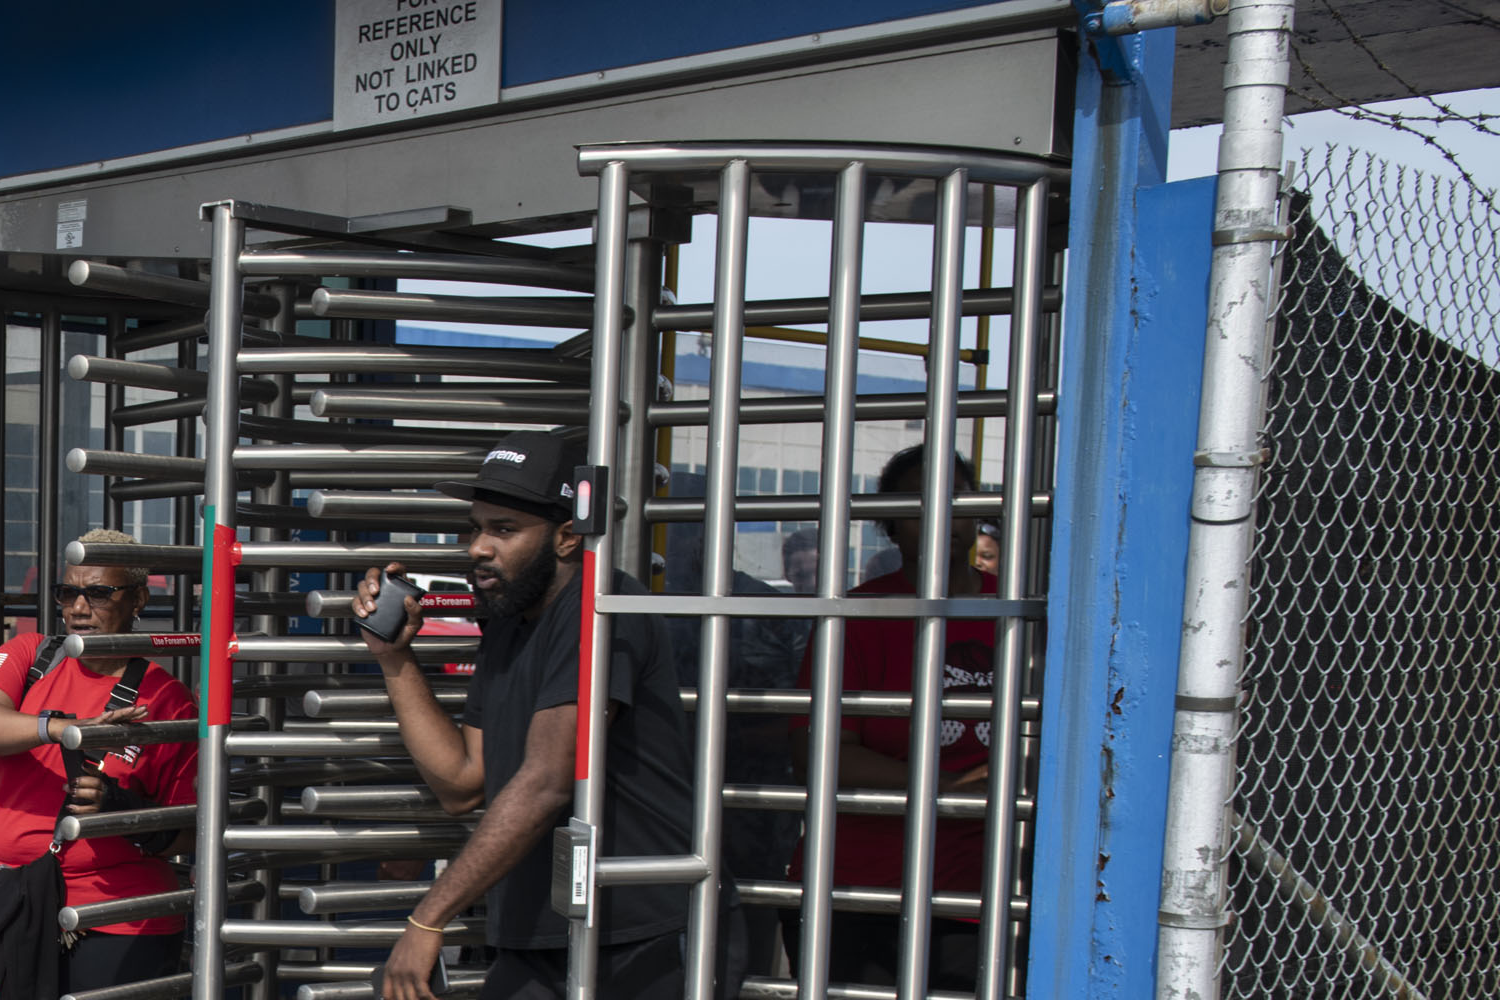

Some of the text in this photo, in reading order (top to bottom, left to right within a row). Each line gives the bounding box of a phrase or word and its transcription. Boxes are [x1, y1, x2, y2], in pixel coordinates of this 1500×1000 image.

[358, 2, 477, 43] REFERENCE
[390, 34, 442, 61] ONLY
[355, 53, 477, 93] NOT LINKED
[374, 81, 456, 113] TO CATS
[484, 450, 526, 464] preme
[436, 597, 471, 606] Forearm
[153, 637, 164, 645] Use
[164, 637, 186, 645] Forearm
